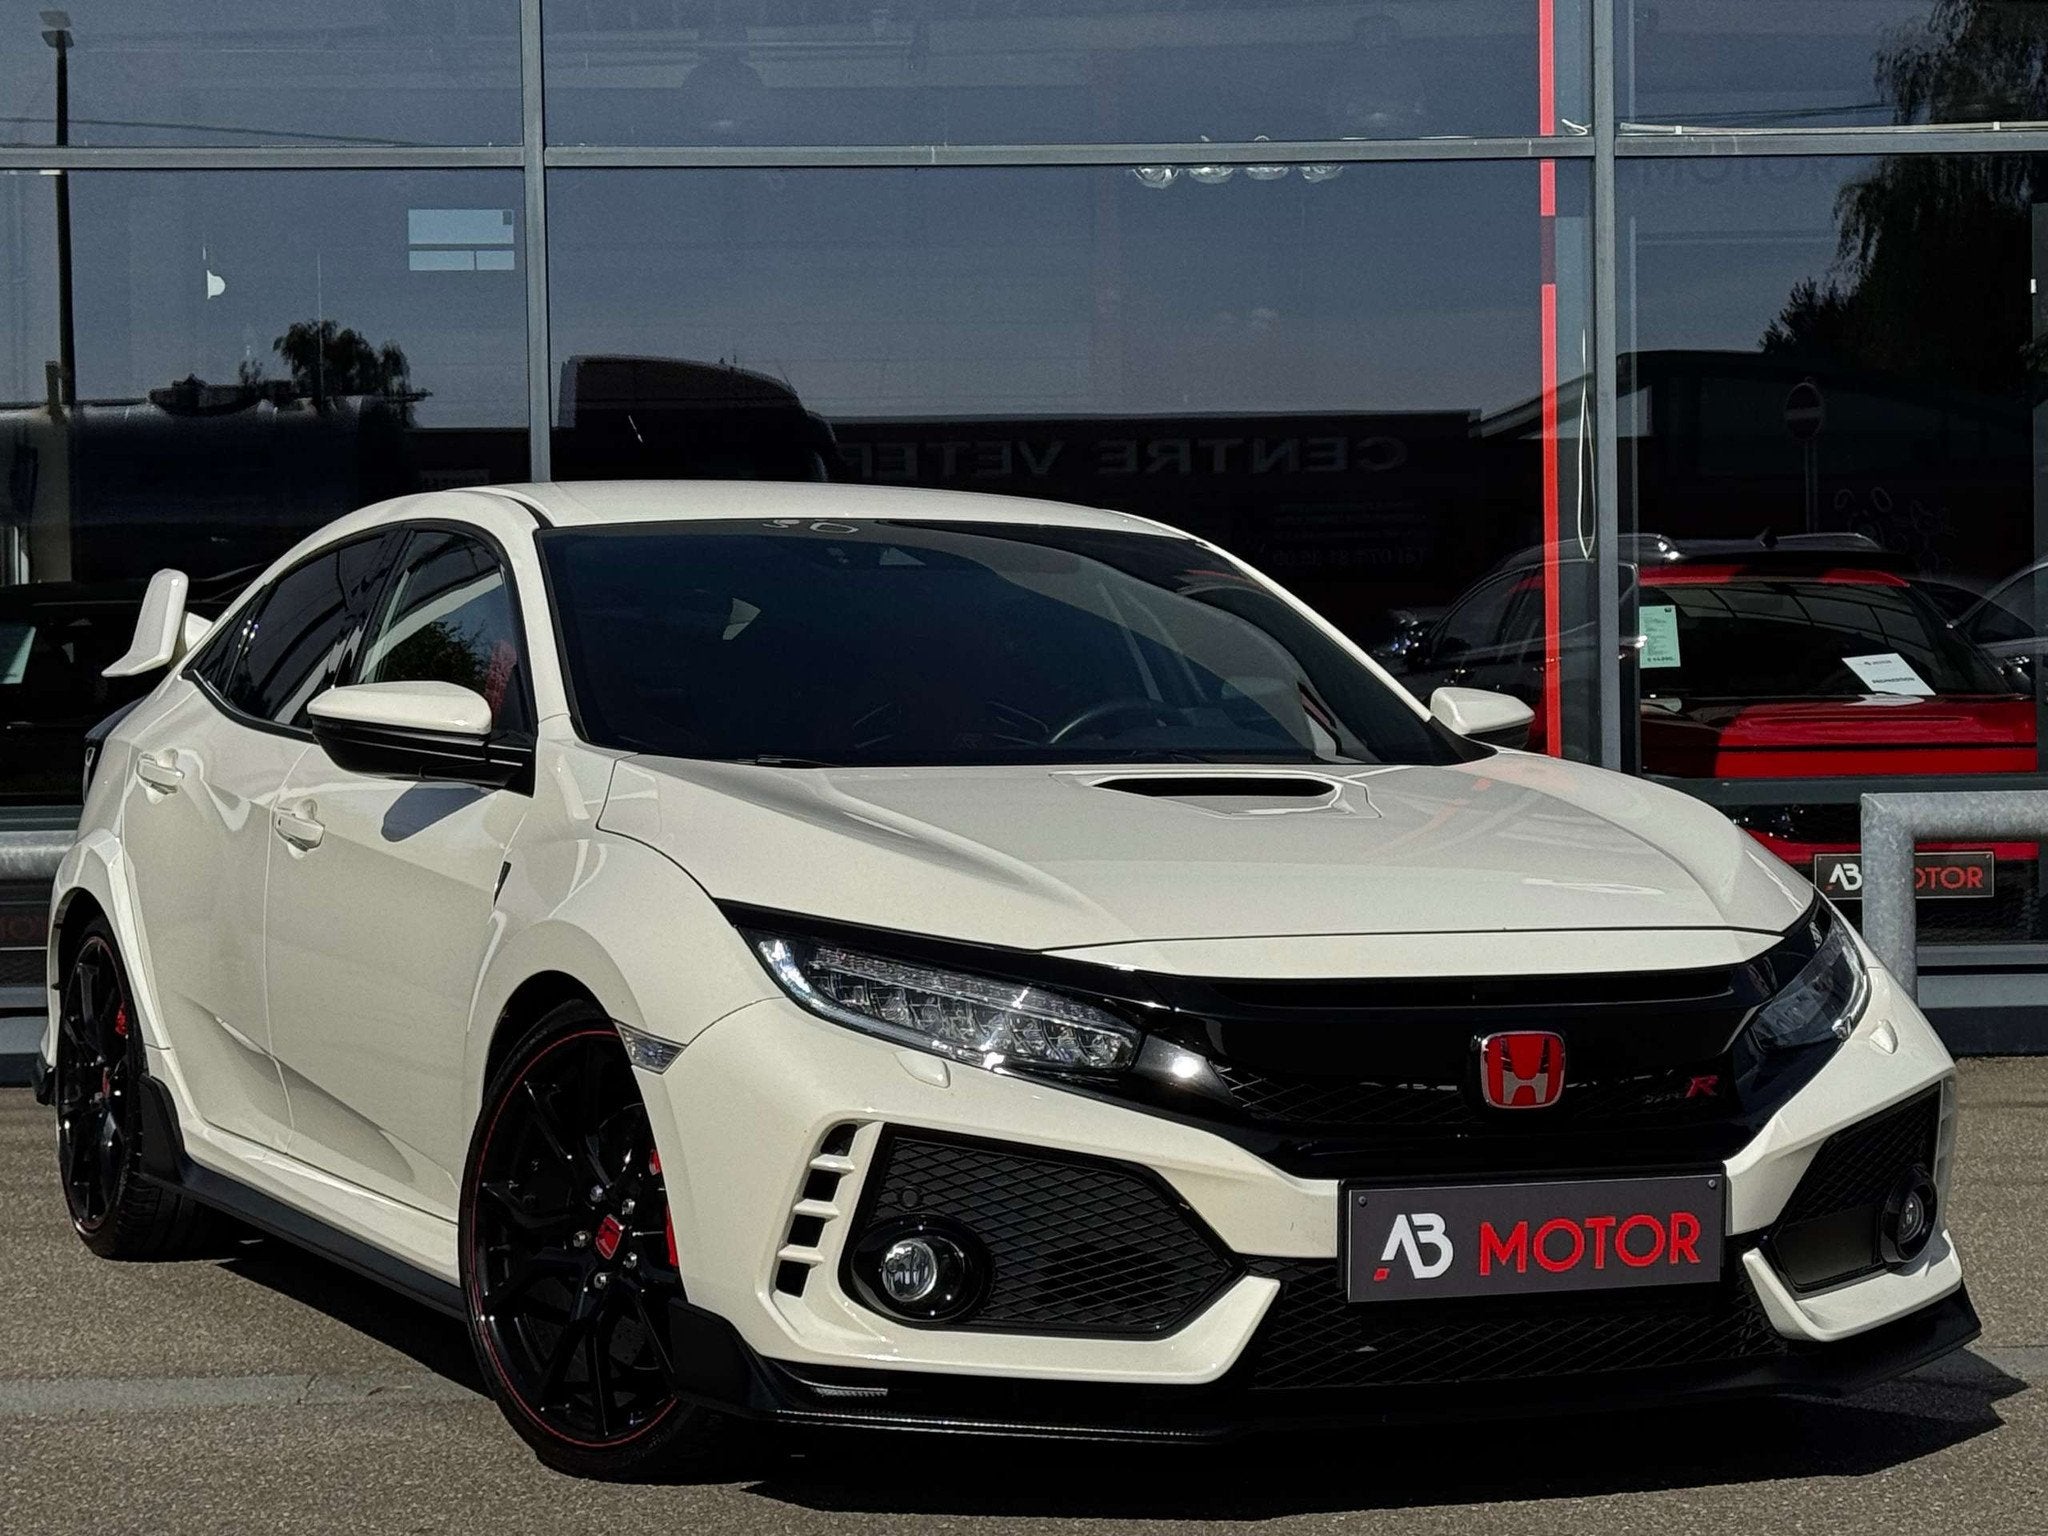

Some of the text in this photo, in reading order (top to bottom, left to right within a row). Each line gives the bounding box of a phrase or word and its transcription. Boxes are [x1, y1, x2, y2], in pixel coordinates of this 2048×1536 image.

[1685, 1075, 1718, 1099] R
[1373, 1211, 1702, 1282] AB MOTOR
